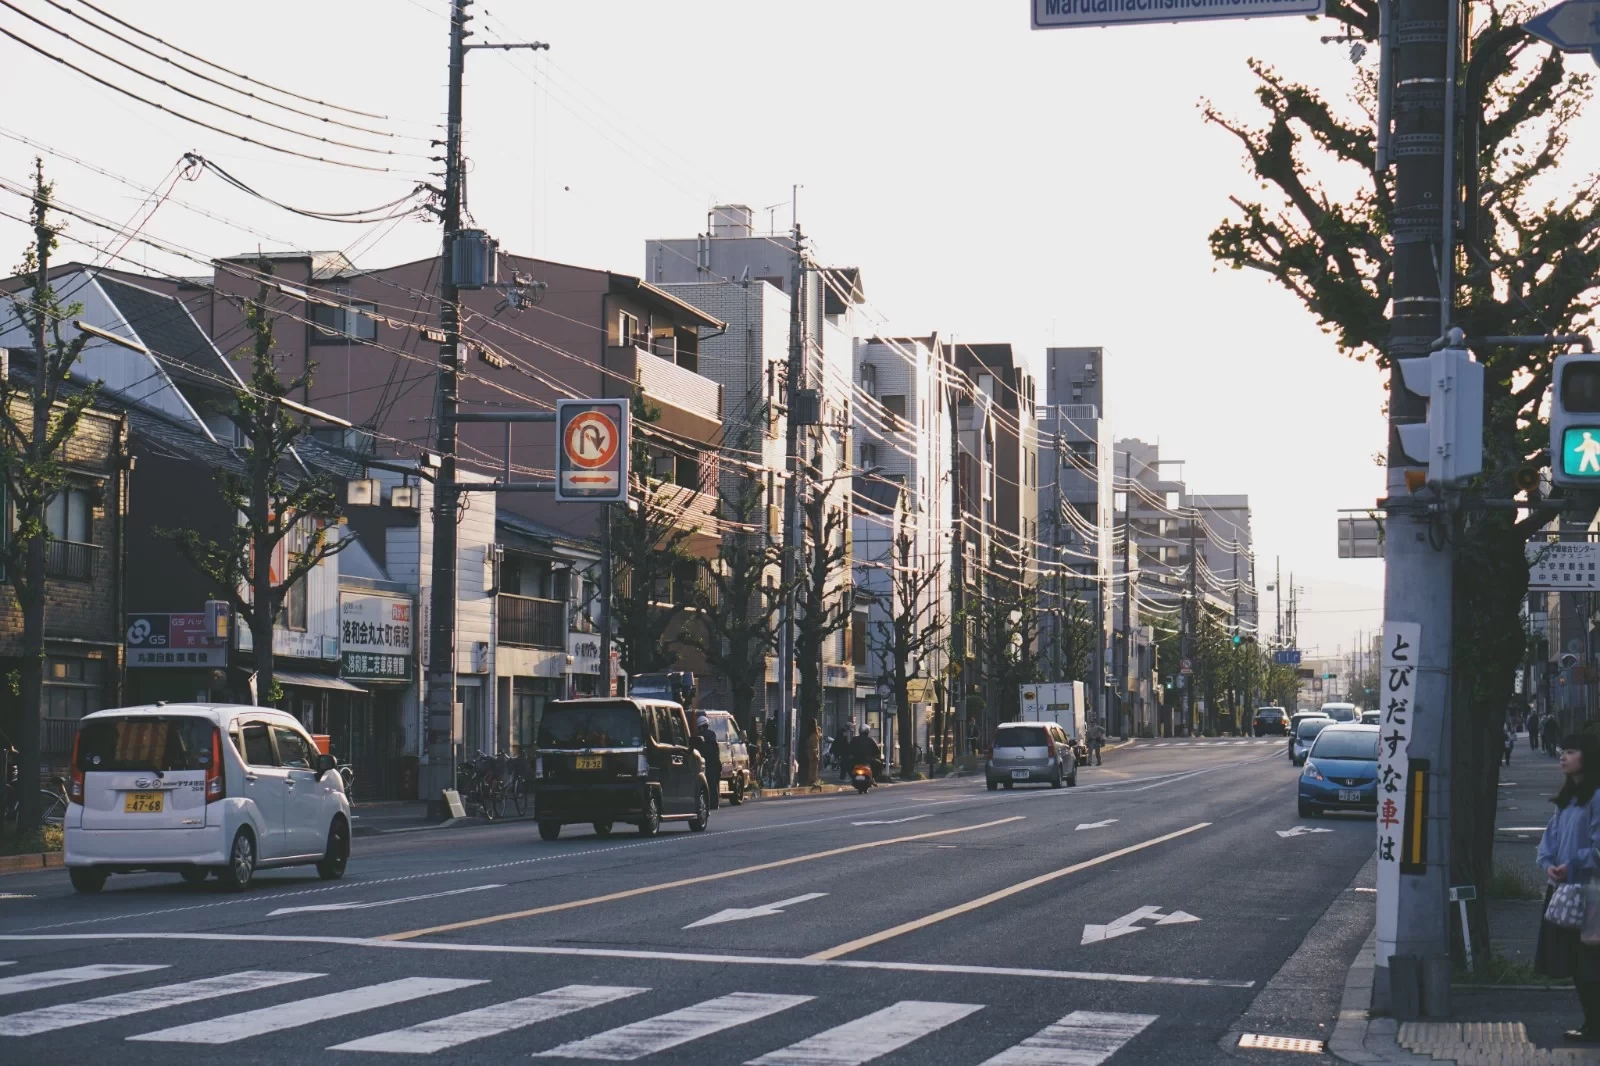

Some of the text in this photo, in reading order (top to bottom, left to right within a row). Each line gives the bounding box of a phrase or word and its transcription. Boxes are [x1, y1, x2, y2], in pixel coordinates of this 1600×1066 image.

[1539, 573, 1595, 581] 中央図書館
[172, 618, 185, 626] GS
[342, 619, 410, 649] 洛和会丸太町病院
[149, 635, 166, 645] GS
[347, 654, 405, 675] 洛和第二若草保育園
[1379, 633, 1415, 862] とびだすな車は
[132, 800, 160, 811] 47-68
